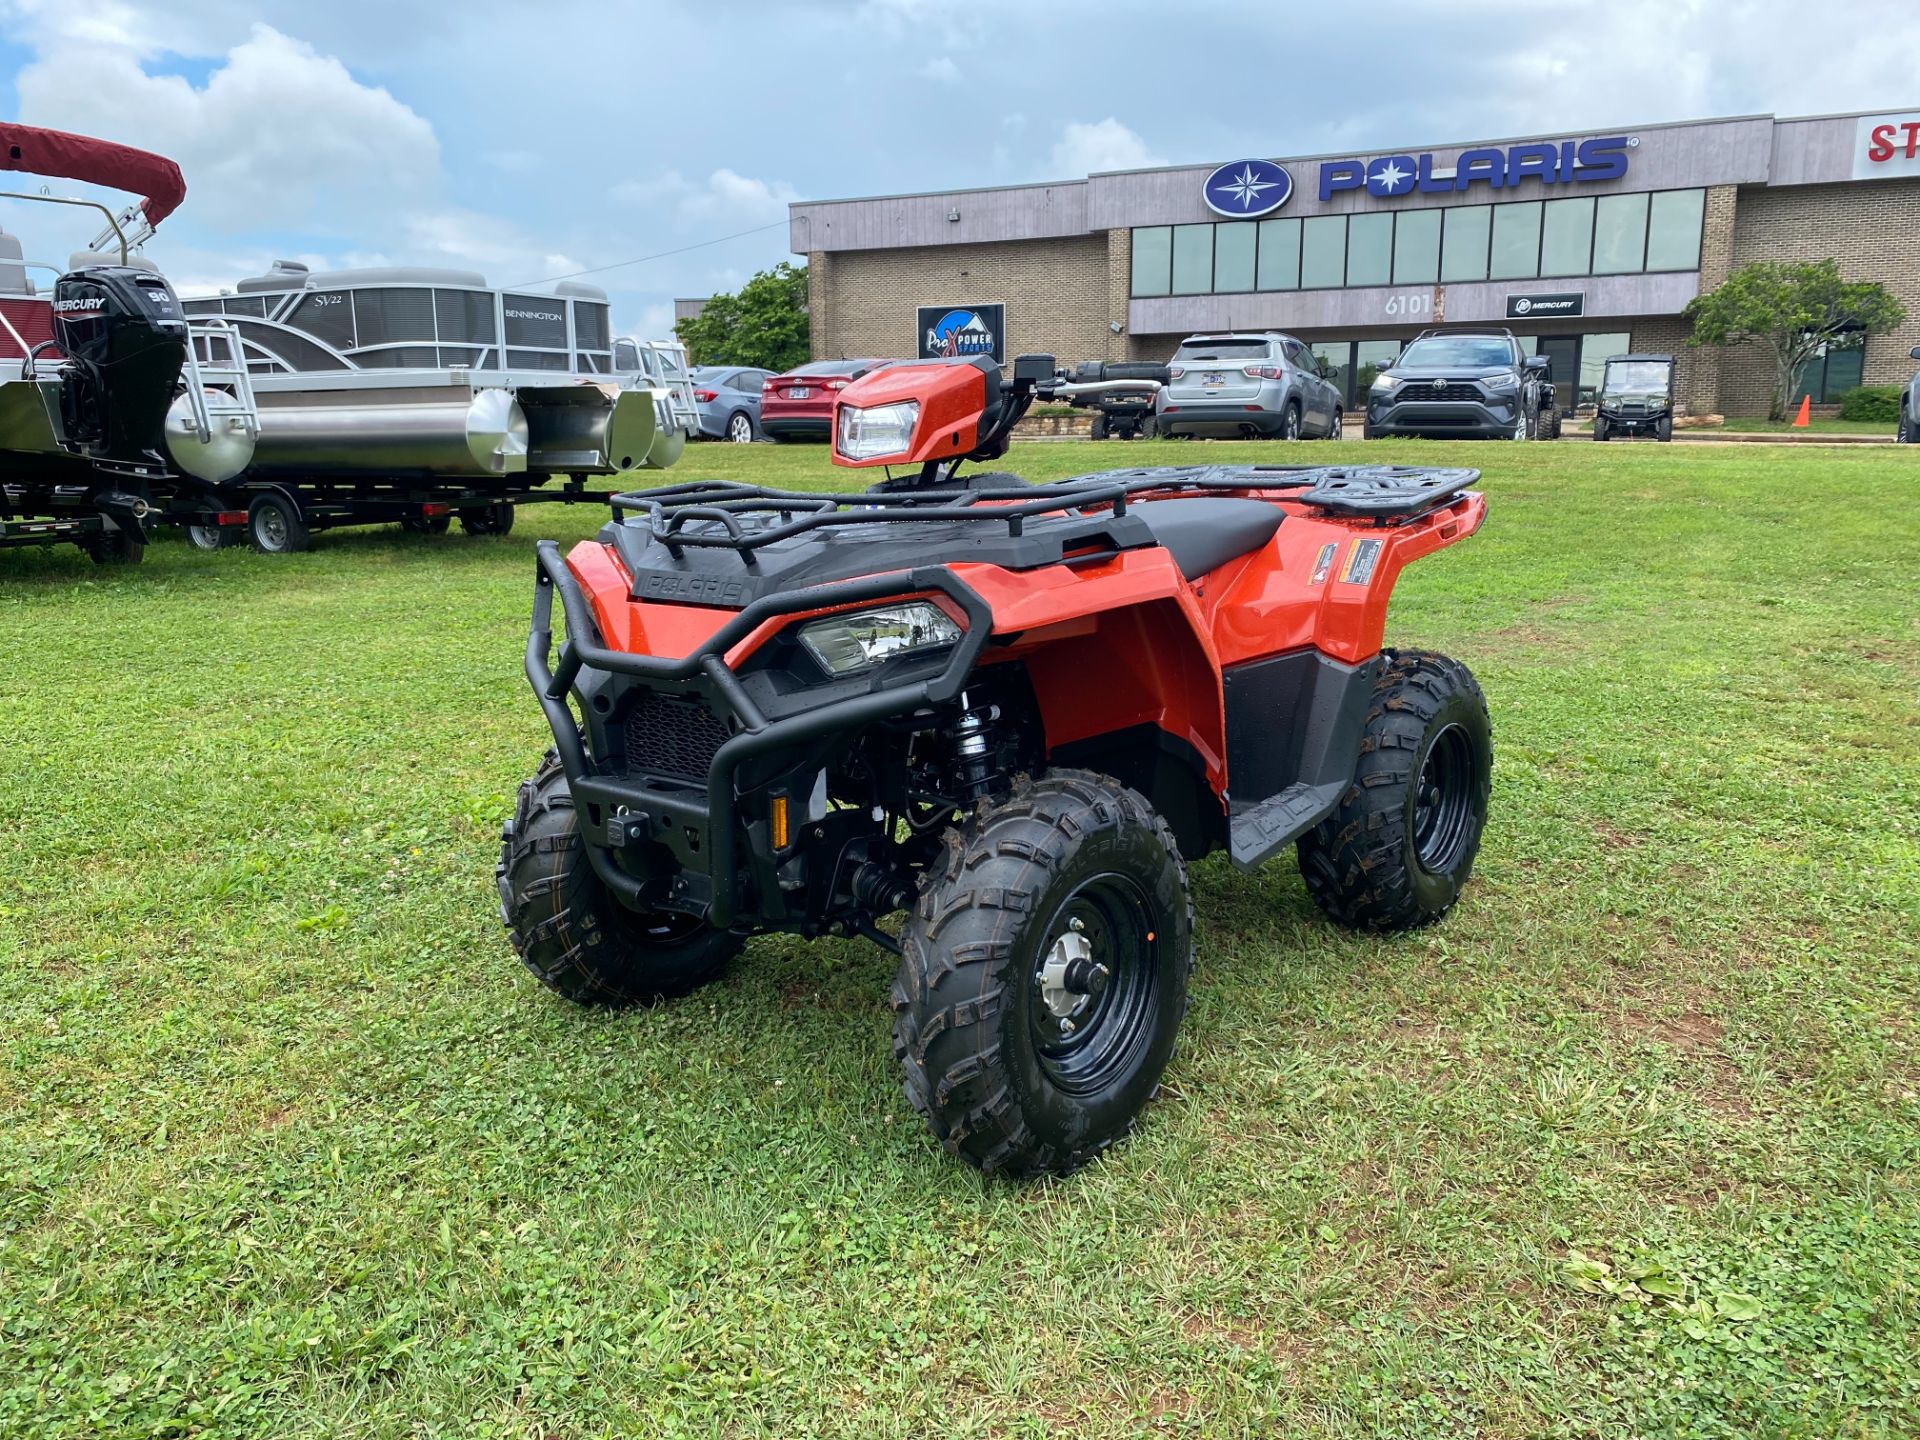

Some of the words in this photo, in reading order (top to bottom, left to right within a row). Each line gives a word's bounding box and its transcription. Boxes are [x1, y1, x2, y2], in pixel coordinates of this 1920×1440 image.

[1319, 137, 1629, 200] POLARIS
[148, 291, 170, 302] 90
[314, 295, 342, 307] SV22
[54, 297, 106, 311] MERCURY
[1385, 294, 1430, 315] 6101
[1531, 301, 1575, 310] MERCURY
[505, 309, 562, 321] BENNINGTON
[958, 334, 991, 345] POWER
[958, 344, 993, 353] SPORTS
[647, 575, 742, 600] POLARIS
